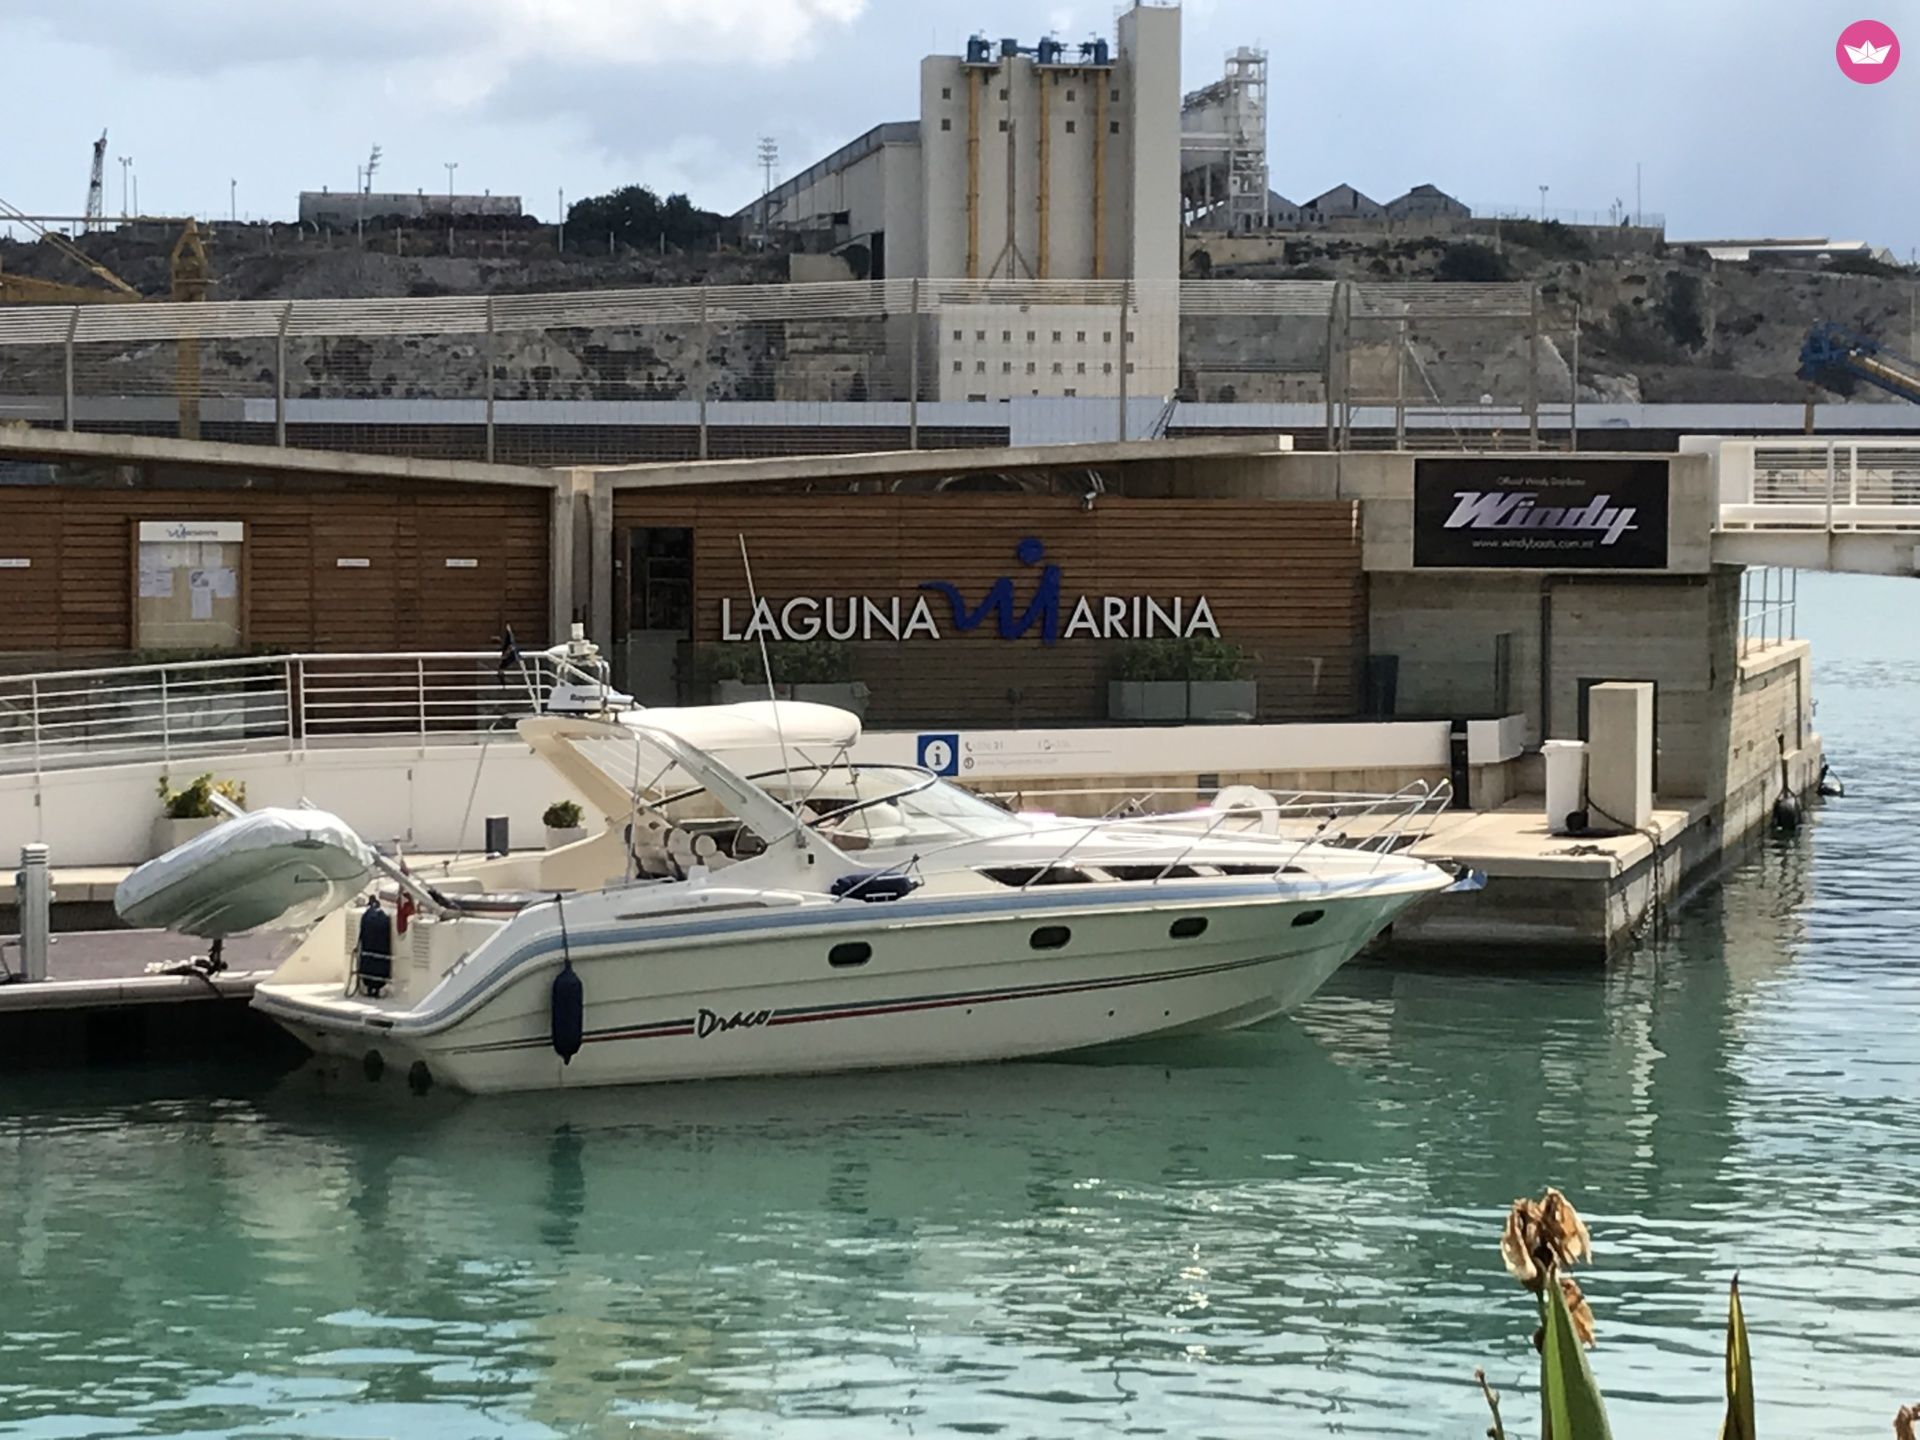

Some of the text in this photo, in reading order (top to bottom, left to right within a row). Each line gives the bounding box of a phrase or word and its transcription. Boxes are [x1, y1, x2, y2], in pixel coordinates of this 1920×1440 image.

[1443, 492, 1639, 545] Windy
[722, 595, 941, 641] LAGUNA
[698, 1008, 771, 1039] Draco
